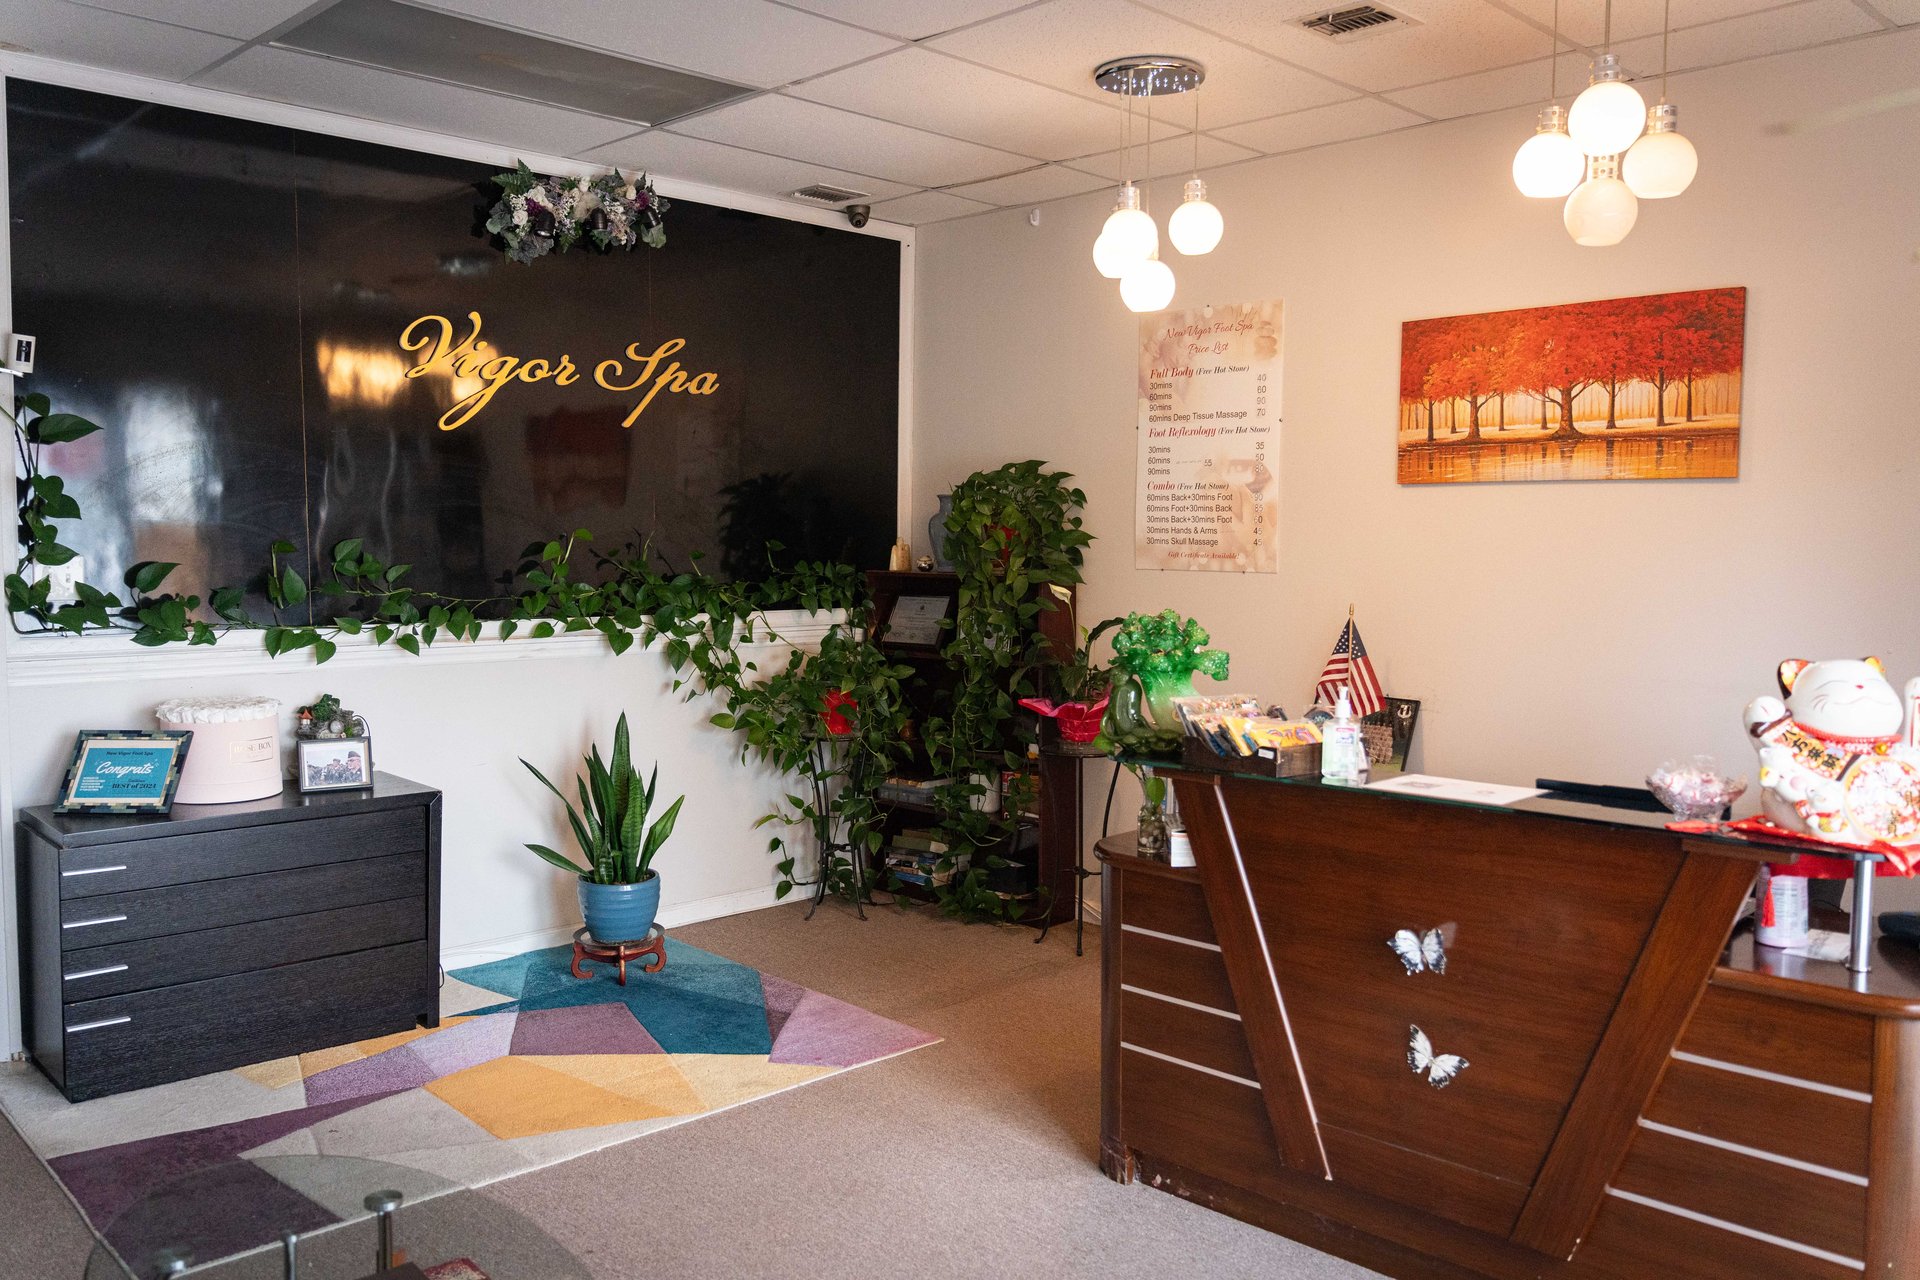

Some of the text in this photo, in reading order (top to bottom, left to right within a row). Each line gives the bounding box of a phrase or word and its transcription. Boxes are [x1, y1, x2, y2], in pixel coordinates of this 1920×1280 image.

[1164, 320, 1254, 341] New Vigor Foot Spa
[1188, 341, 1229, 355] Price List
[399, 311, 720, 432] Vigor Spa
[1150, 365, 1250, 379] Full Body (Free Hot Stone)
[1257, 374, 1266, 382] 40
[1150, 382, 1172, 390] 30mins
[1149, 393, 1172, 401] 60mins
[1256, 397, 1266, 405] 90
[1149, 404, 1172, 412] 90mins
[1256, 408, 1266, 416] 70
[1149, 411, 1247, 422] 60mins Deep Tissue Massage
[1149, 427, 1166, 438] Foot
[1168, 426, 1217, 438] Reflexology
[1236, 426, 1248, 434] Hot
[1148, 446, 1171, 454] 30mins
[1256, 442, 1264, 450] 35
[1147, 480, 1176, 490] Combo
[1177, 482, 1193, 490] (Free
[1171, 493, 1216, 501] Back+30mins
[1147, 503, 1233, 512] 60mins Foot+30mins Back
[1170, 515, 1215, 523] Back+30mins
[1216, 515, 1232, 523] Foot
[1146, 526, 1169, 534] 30mins
[1170, 526, 1192, 534] Hands
[1194, 526, 1199, 534] &
[1170, 537, 1187, 545] Skull
[1188, 537, 1218, 547] Massage
[258, 742, 271, 750] BOX
[96, 761, 154, 778] Congrats
